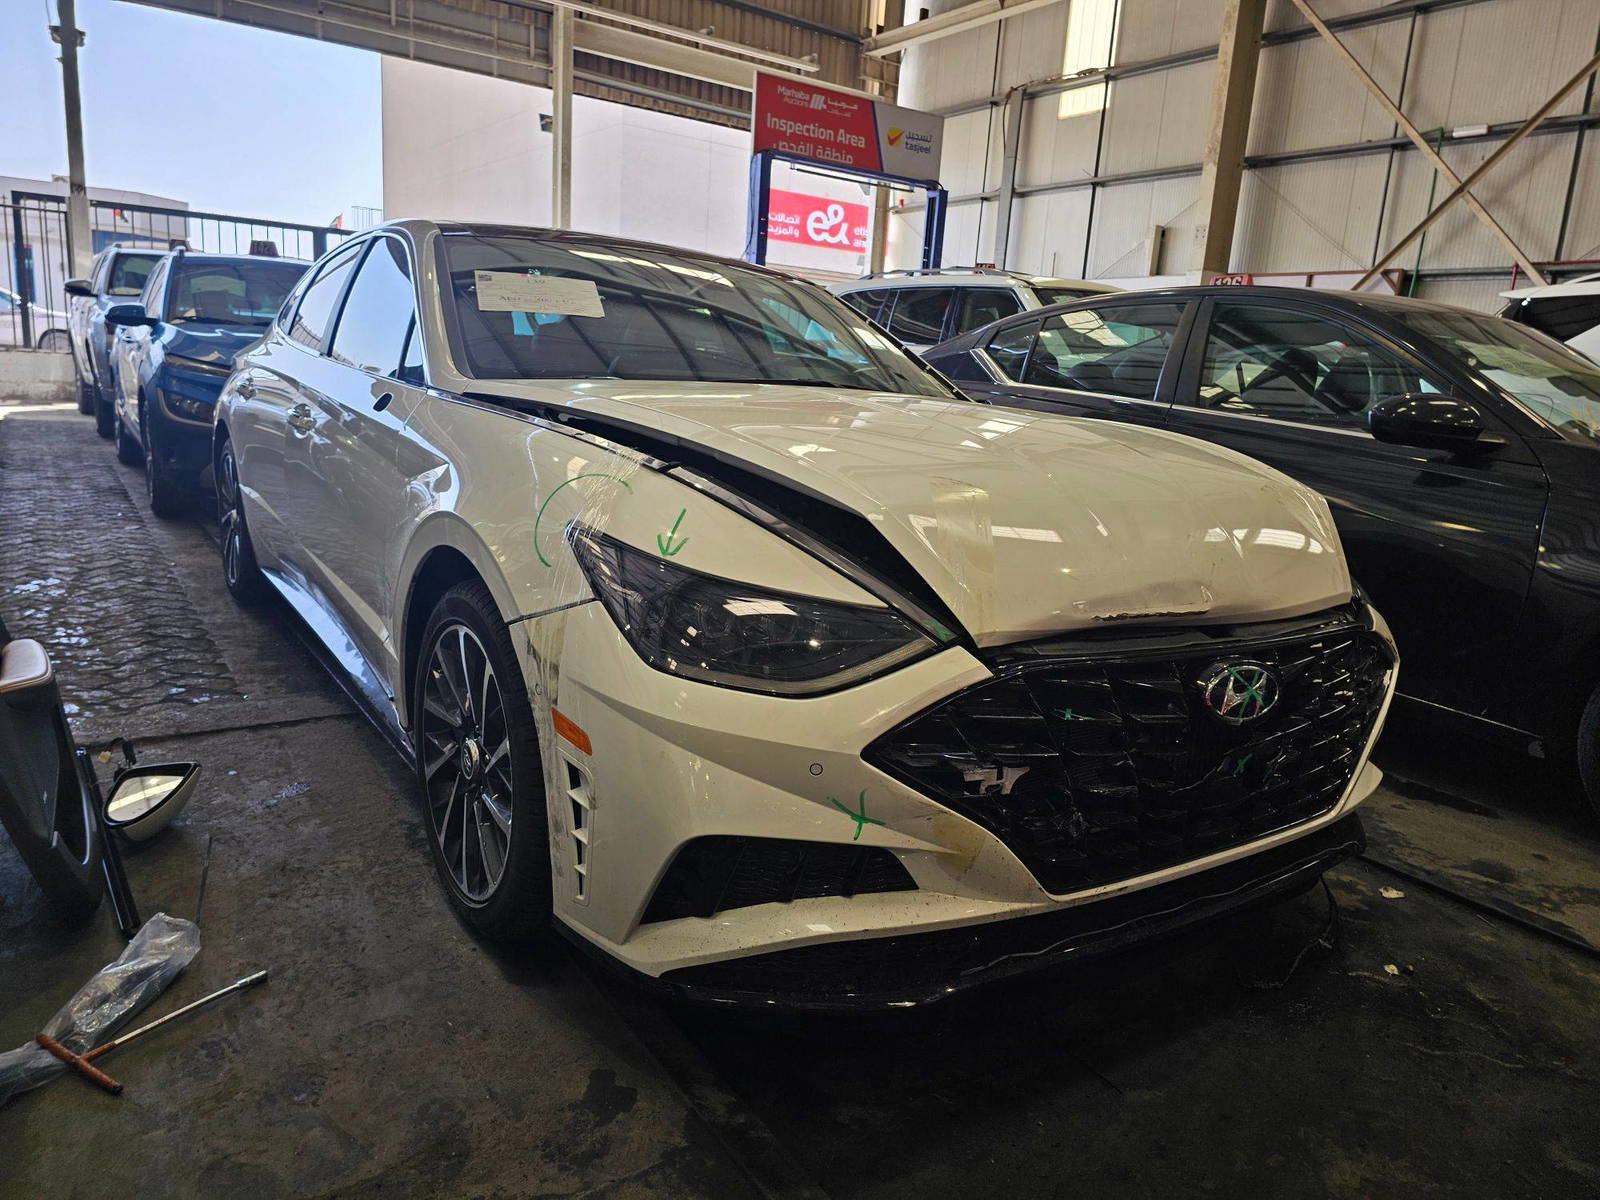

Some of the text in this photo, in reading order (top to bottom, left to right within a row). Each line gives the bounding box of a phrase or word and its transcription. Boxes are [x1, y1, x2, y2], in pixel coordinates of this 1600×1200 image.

[777, 85, 809, 100] Marhaba
[766, 112, 866, 148] Inspection Area
[816, 145, 854, 164] منطقة
[905, 141, 931, 154] tasjeel
